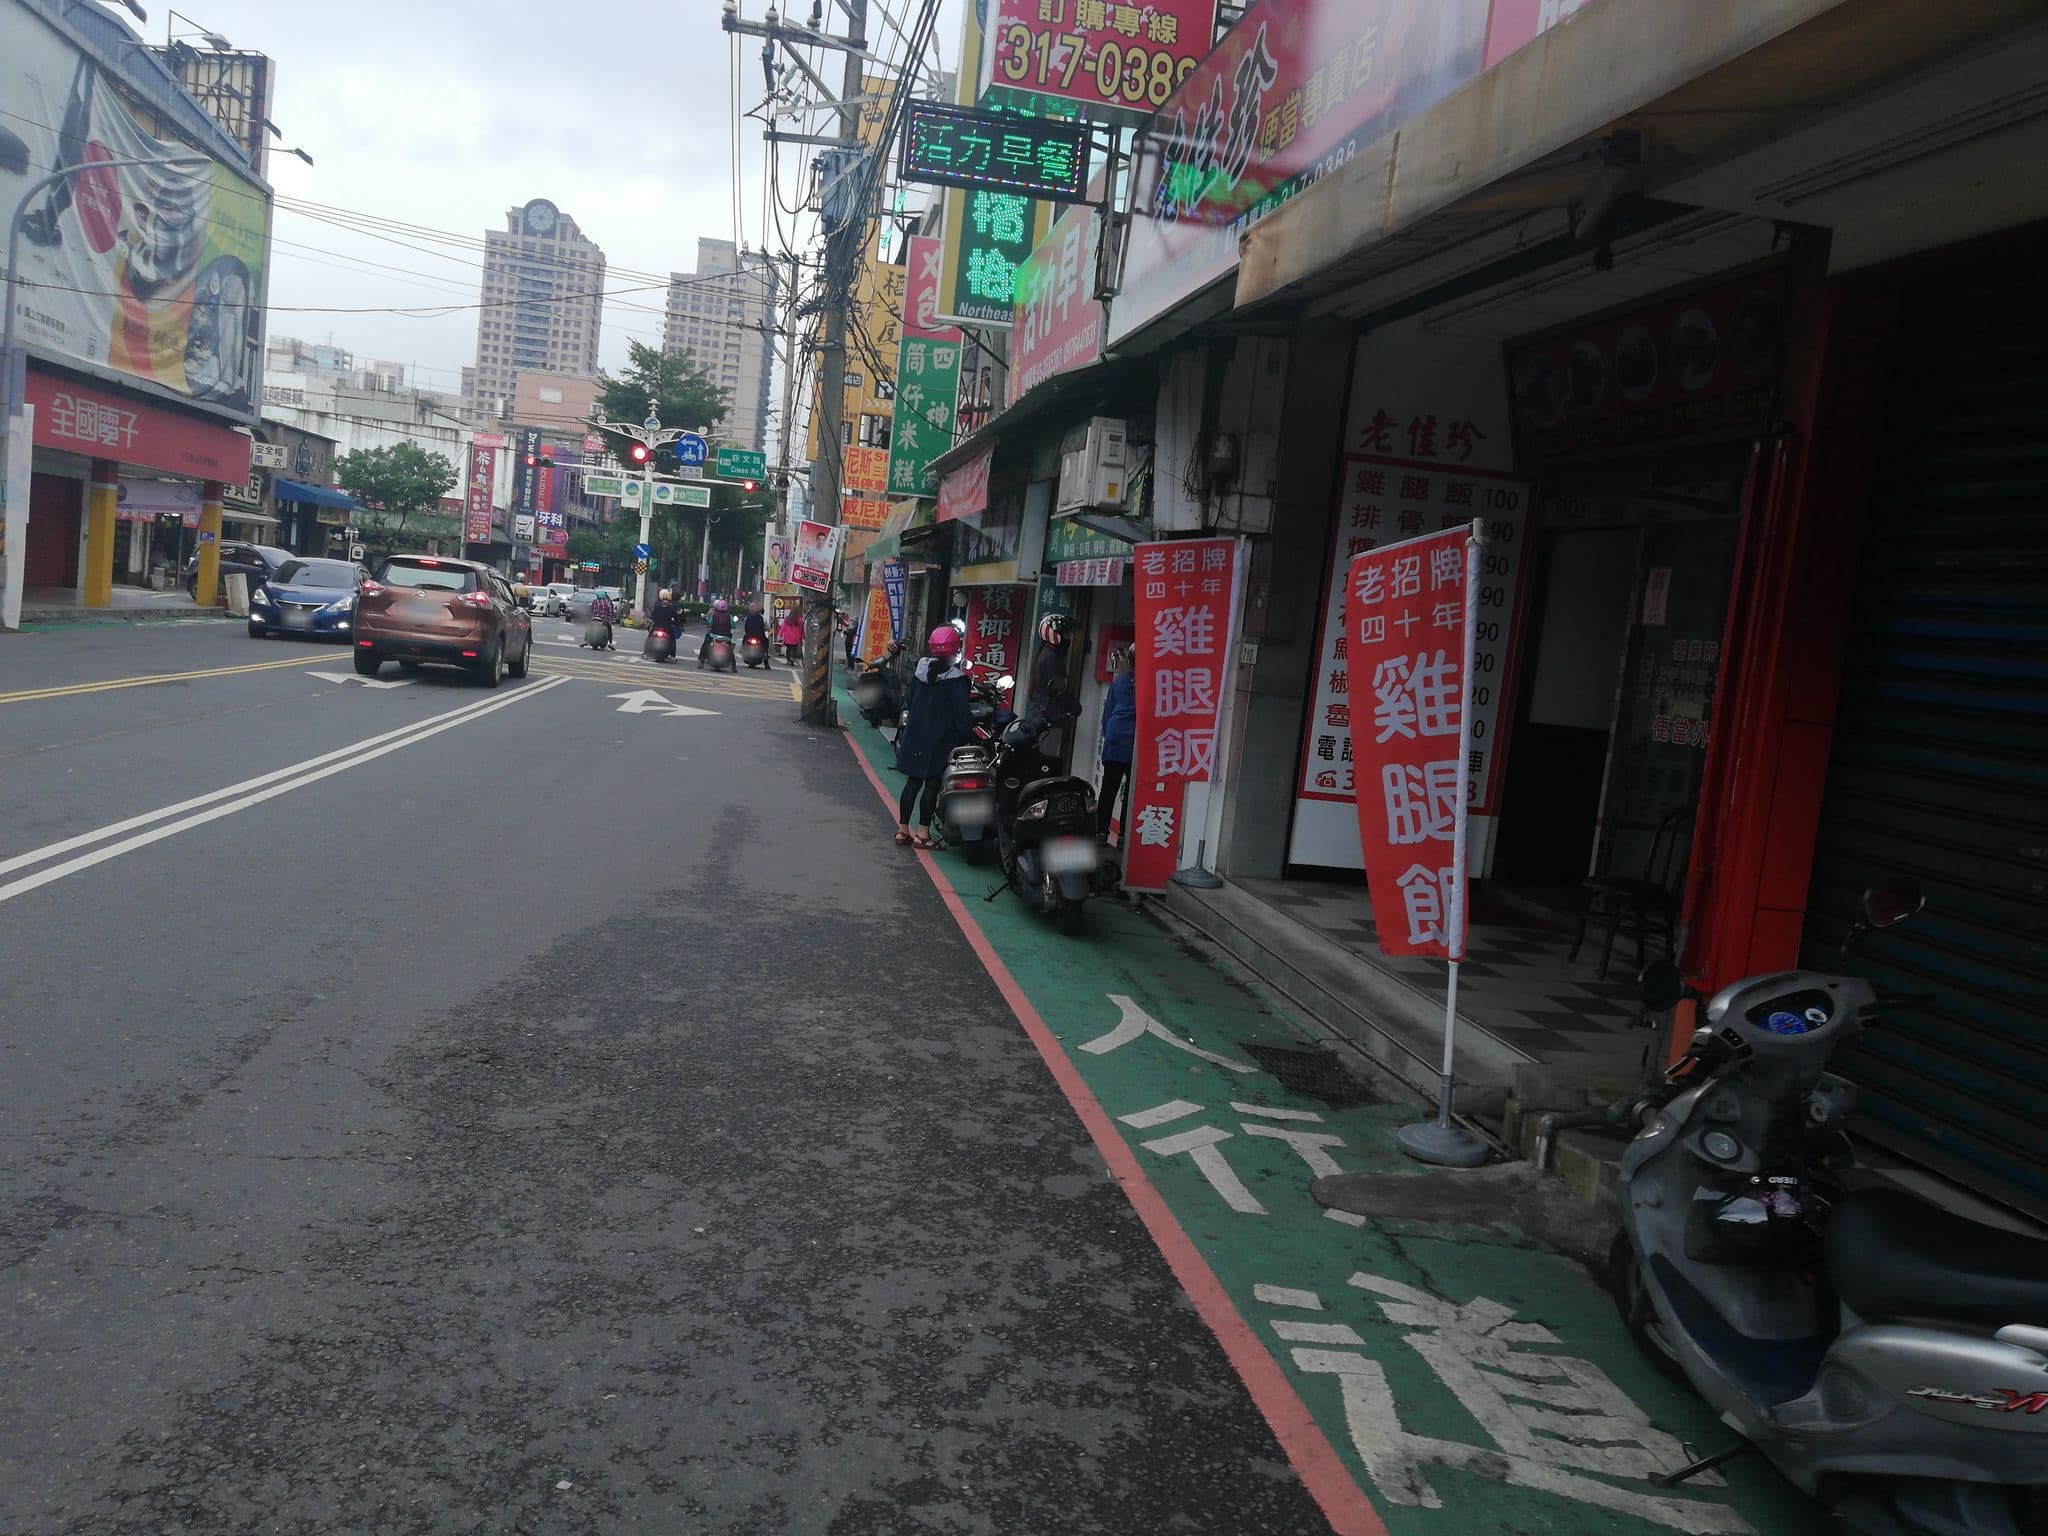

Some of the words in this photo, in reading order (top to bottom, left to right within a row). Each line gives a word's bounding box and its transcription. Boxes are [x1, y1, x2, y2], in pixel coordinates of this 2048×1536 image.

[1038, 0, 1179, 45] 訂購專線
[915, 119, 1075, 184] 活力早餐
[50, 392, 140, 449] 全國電子
[893, 341, 926, 490] 筒仔米糕
[1359, 408, 1487, 460] 老佳珍
[1355, 469, 1474, 507] 雞腿飯
[1485, 487, 1518, 511] 100
[539, 511, 563, 527] 牙科
[1490, 523, 1514, 543] 90
[1141, 547, 1227, 576] 老招牌
[1355, 545, 1463, 605] 老招牌
[1486, 555, 1509, 576] 90
[1145, 578, 1223, 600] 四十年
[1481, 587, 1504, 607] 90
[1360, 601, 1463, 644] 四十年
[1476, 622, 1499, 641] 90
[1153, 604, 1215, 777] 雞腿飯
